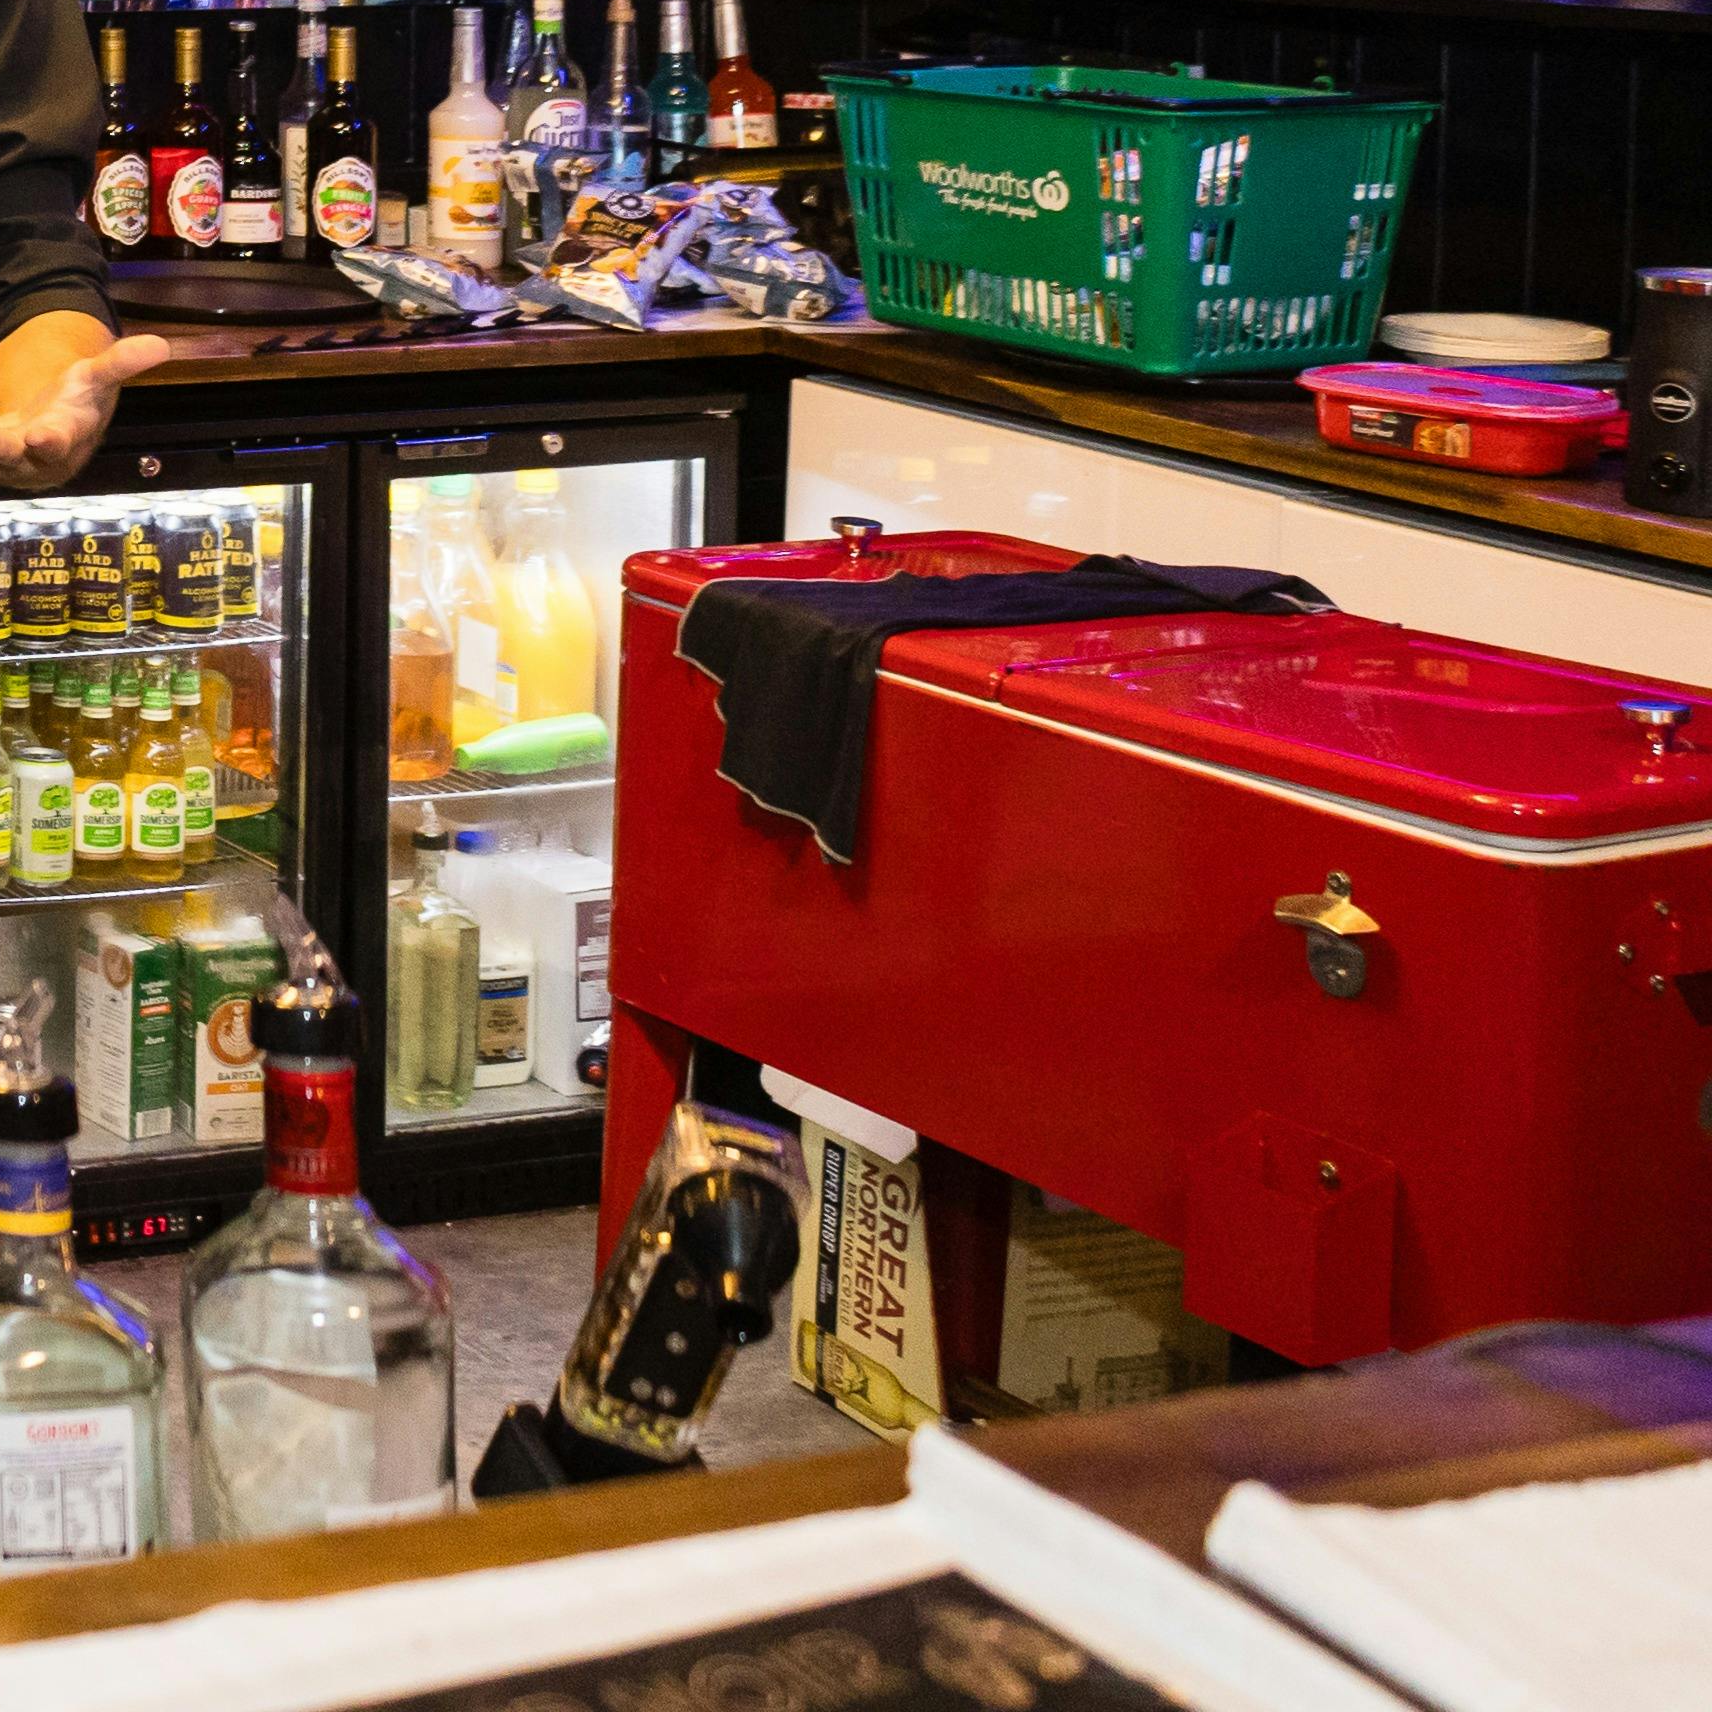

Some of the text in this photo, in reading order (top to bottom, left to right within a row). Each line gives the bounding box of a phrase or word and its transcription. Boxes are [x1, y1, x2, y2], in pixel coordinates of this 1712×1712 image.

[918, 160, 1032, 200] Woolworths
[28, 557, 66, 569] HARD
[223, 550, 254, 566] TED
[17, 569, 71, 585] RATED
[77, 566, 122, 584] ATED
[32, 816, 72, 830] SOMERSB
[217, 1071, 263, 1081] BARISTA
[822, 1147, 841, 1254] SUPER CRISP
[843, 1180, 858, 1271] BREWING
[853, 1159, 880, 1340] NORTHERN
[875, 1173, 911, 1359] GREAT
